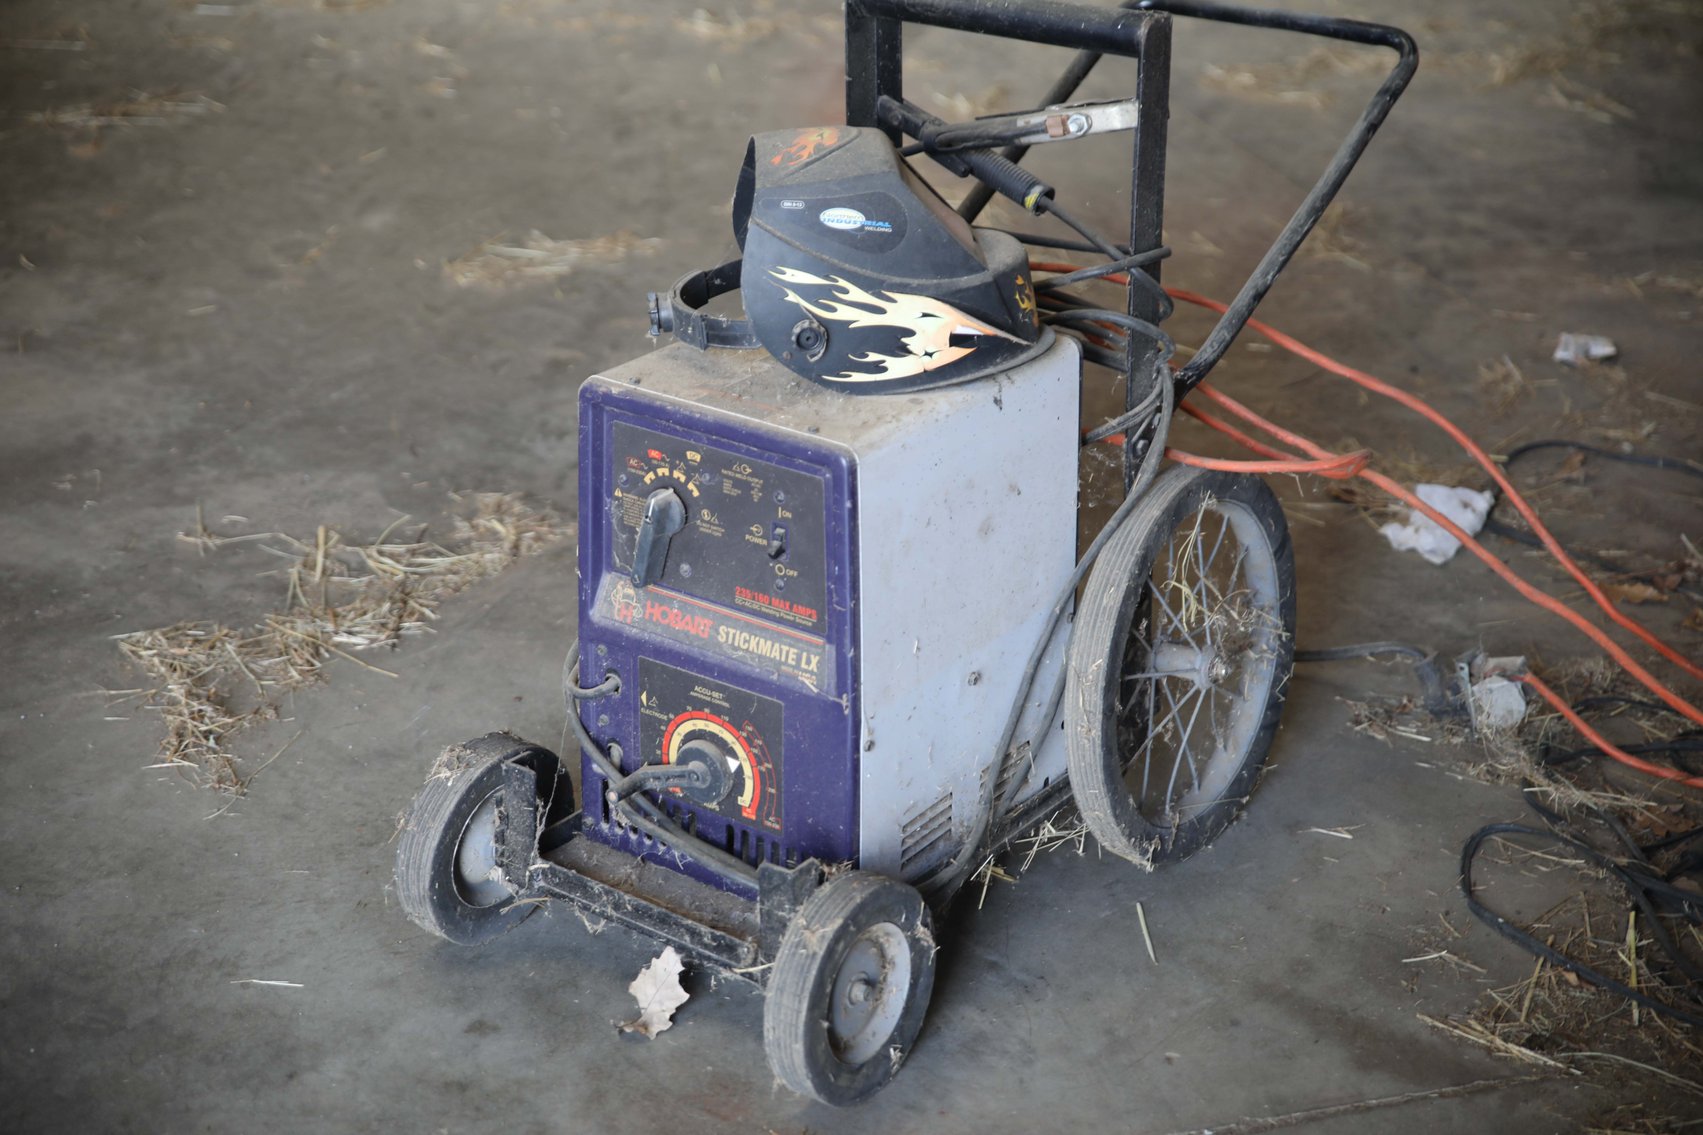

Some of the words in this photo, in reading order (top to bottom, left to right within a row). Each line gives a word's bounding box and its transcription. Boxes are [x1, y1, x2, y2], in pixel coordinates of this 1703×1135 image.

[822, 217, 892, 228] INDUSTRIAL
[864, 225, 893, 233] WELDING
[629, 458, 638, 466] AC
[782, 510, 792, 519] ON
[745, 534, 768, 546] POWER
[786, 568, 798, 577] OFF
[771, 596, 791, 611] MAX
[792, 603, 818, 621] AMPS
[645, 600, 712, 639] HOBART
[718, 624, 798, 666] STICKMATE
[801, 651, 820, 673] LX
[640, 707, 668, 721] ELECTRODE
